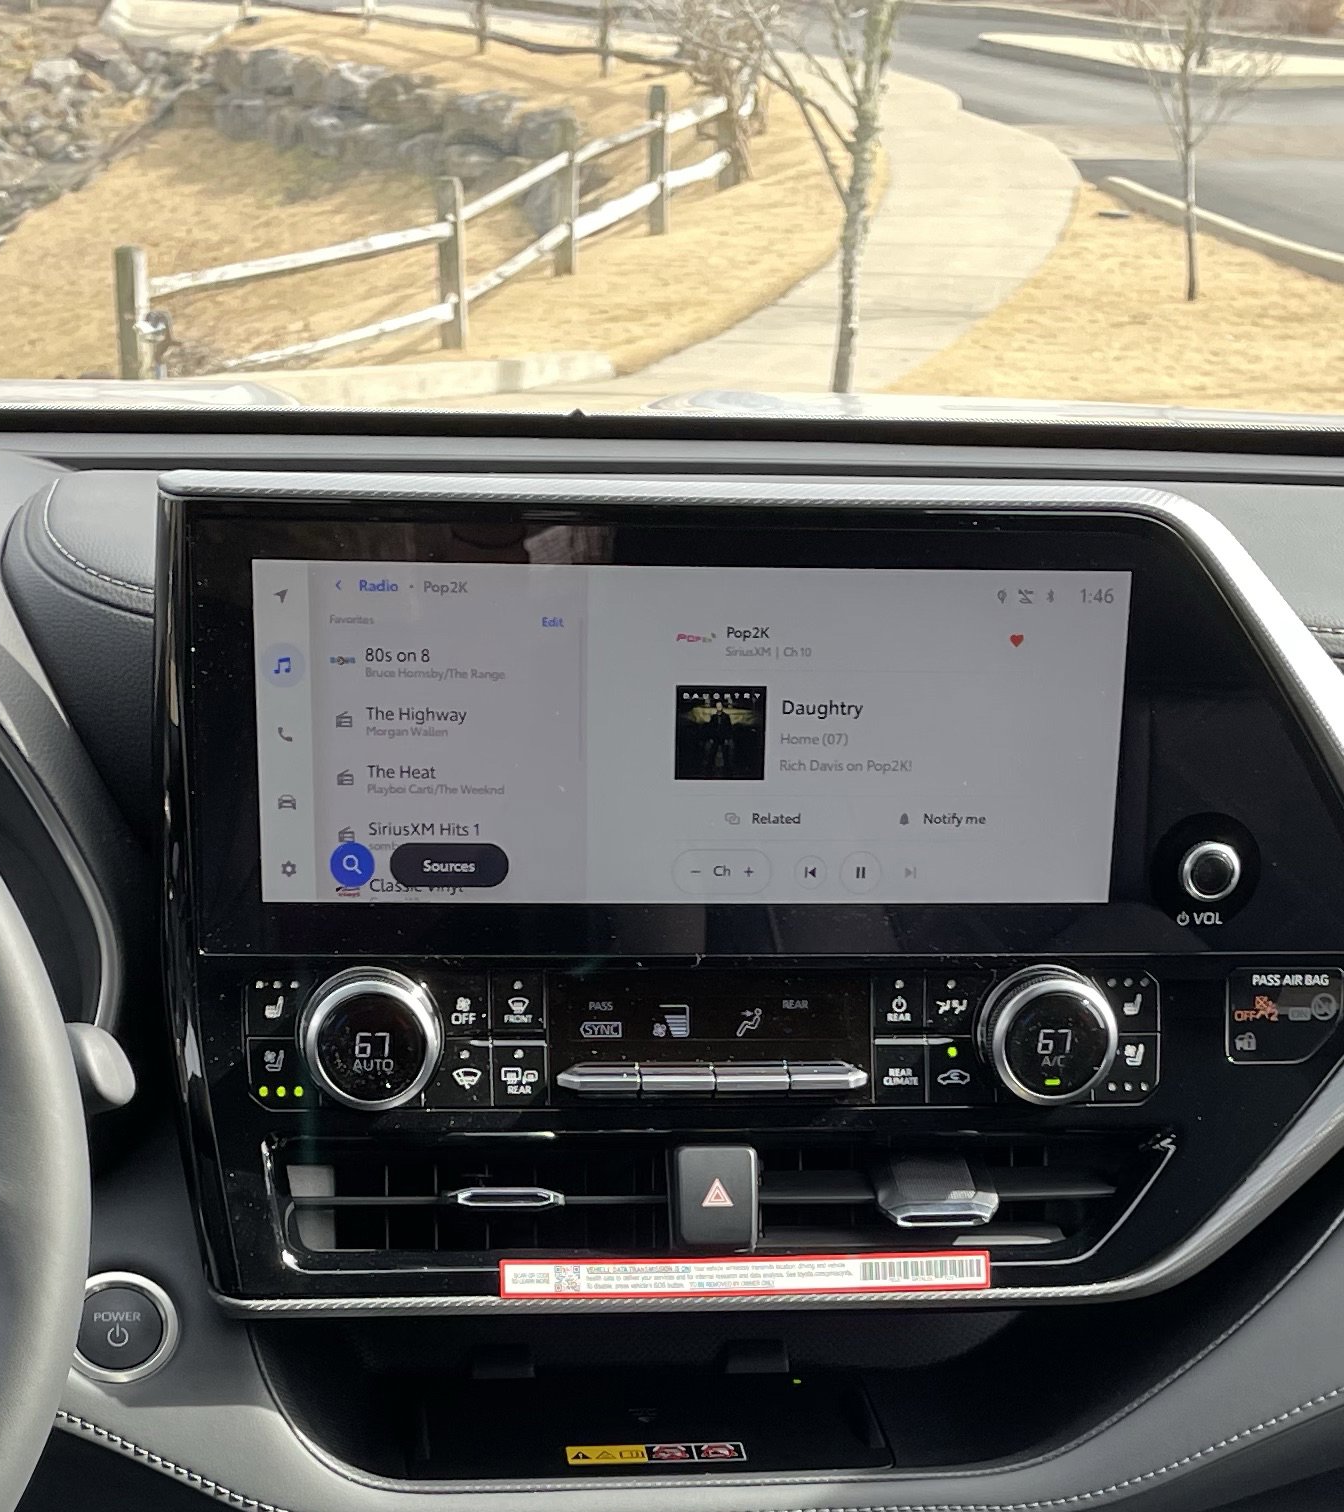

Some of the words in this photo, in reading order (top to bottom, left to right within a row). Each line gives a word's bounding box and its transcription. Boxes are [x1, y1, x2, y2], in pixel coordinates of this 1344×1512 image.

[358, 579, 399, 593] Radio
[422, 580, 468, 595] Pop2K
[1079, 588, 1114, 604] 1:46
[329, 615, 374, 626] Favorites
[541, 616, 564, 628] Edit
[726, 626, 770, 642] Pop2K
[365, 648, 392, 663] 80s
[396, 652, 417, 663] on
[420, 648, 431, 663] 8
[725, 646, 772, 658] SiriusXM
[783, 646, 798, 658] Ch
[800, 647, 812, 658] 10
[365, 668, 395, 680] Bruce
[470, 668, 506, 682] Range
[366, 707, 394, 722] The
[398, 707, 467, 725] Highway
[781, 700, 863, 720] Daughtry
[366, 726, 407, 739] Morgan
[409, 727, 448, 738] Wallen
[780, 733, 820, 746] Home
[367, 765, 396, 780] The
[399, 765, 437, 780] Heat
[779, 760, 808, 773] Rich
[809, 760, 845, 773] Davis
[847, 763, 864, 773] on
[866, 760, 912, 776] Pop2K!
[367, 784, 406, 797] Playboi
[461, 784, 505, 796] Weeknd
[752, 812, 801, 826] Related
[923, 812, 963, 828] Notify
[965, 816, 987, 826] me
[368, 822, 435, 837] SiriusXM
[439, 822, 470, 837] Hits
[473, 823, 481, 837] 1
[422, 859, 476, 874] Sources
[713, 865, 731, 878] Ch
[1193, 911, 1223, 926] VOL
[1252, 974, 1281, 987] PASS
[1282, 974, 1304, 987] AIR
[1305, 974, 1330, 987] BAG
[588, 1001, 613, 1011] PASS
[782, 999, 809, 1010] REAR
[451, 1012, 476, 1026] OFF
[503, 1013, 533, 1024] FRONT
[886, 1012, 912, 1023] REAR
[1234, 1010, 1256, 1022] OFF
[584, 1023, 620, 1036] SYNC
[354, 1031, 391, 1058] 67
[1037, 1029, 1072, 1055] 67
[352, 1058, 394, 1072] AUTO
[888, 1068, 913, 1078] REAR
[882, 1076, 919, 1087] CLIMATE
[506, 1084, 532, 1095] REAR
[93, 1311, 141, 1322] POWER
